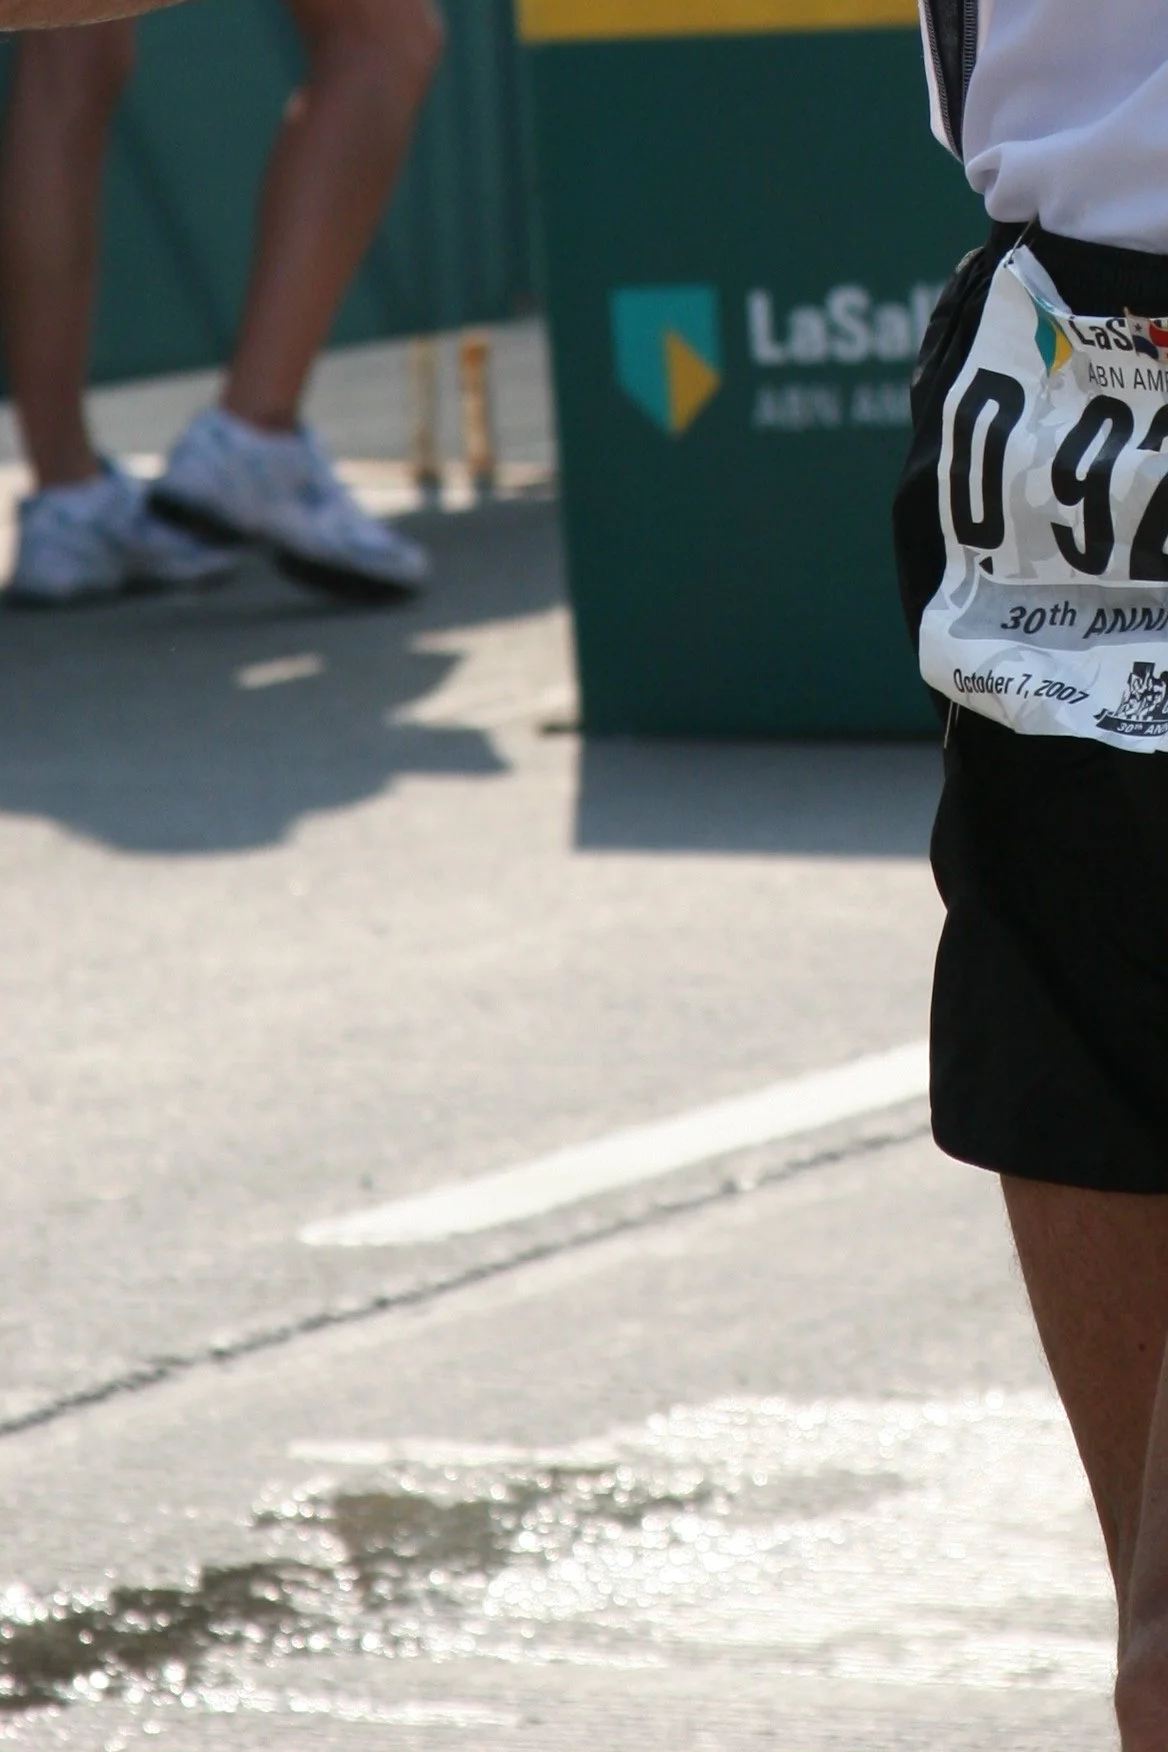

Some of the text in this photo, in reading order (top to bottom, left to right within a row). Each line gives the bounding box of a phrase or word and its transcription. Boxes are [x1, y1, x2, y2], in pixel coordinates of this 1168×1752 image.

[1088, 361, 1126, 390] ABN
[1000, 600, 1077, 636] 30th
[953, 668, 1090, 707] October 7, 2007
[1116, 721, 1144, 734] 30th
